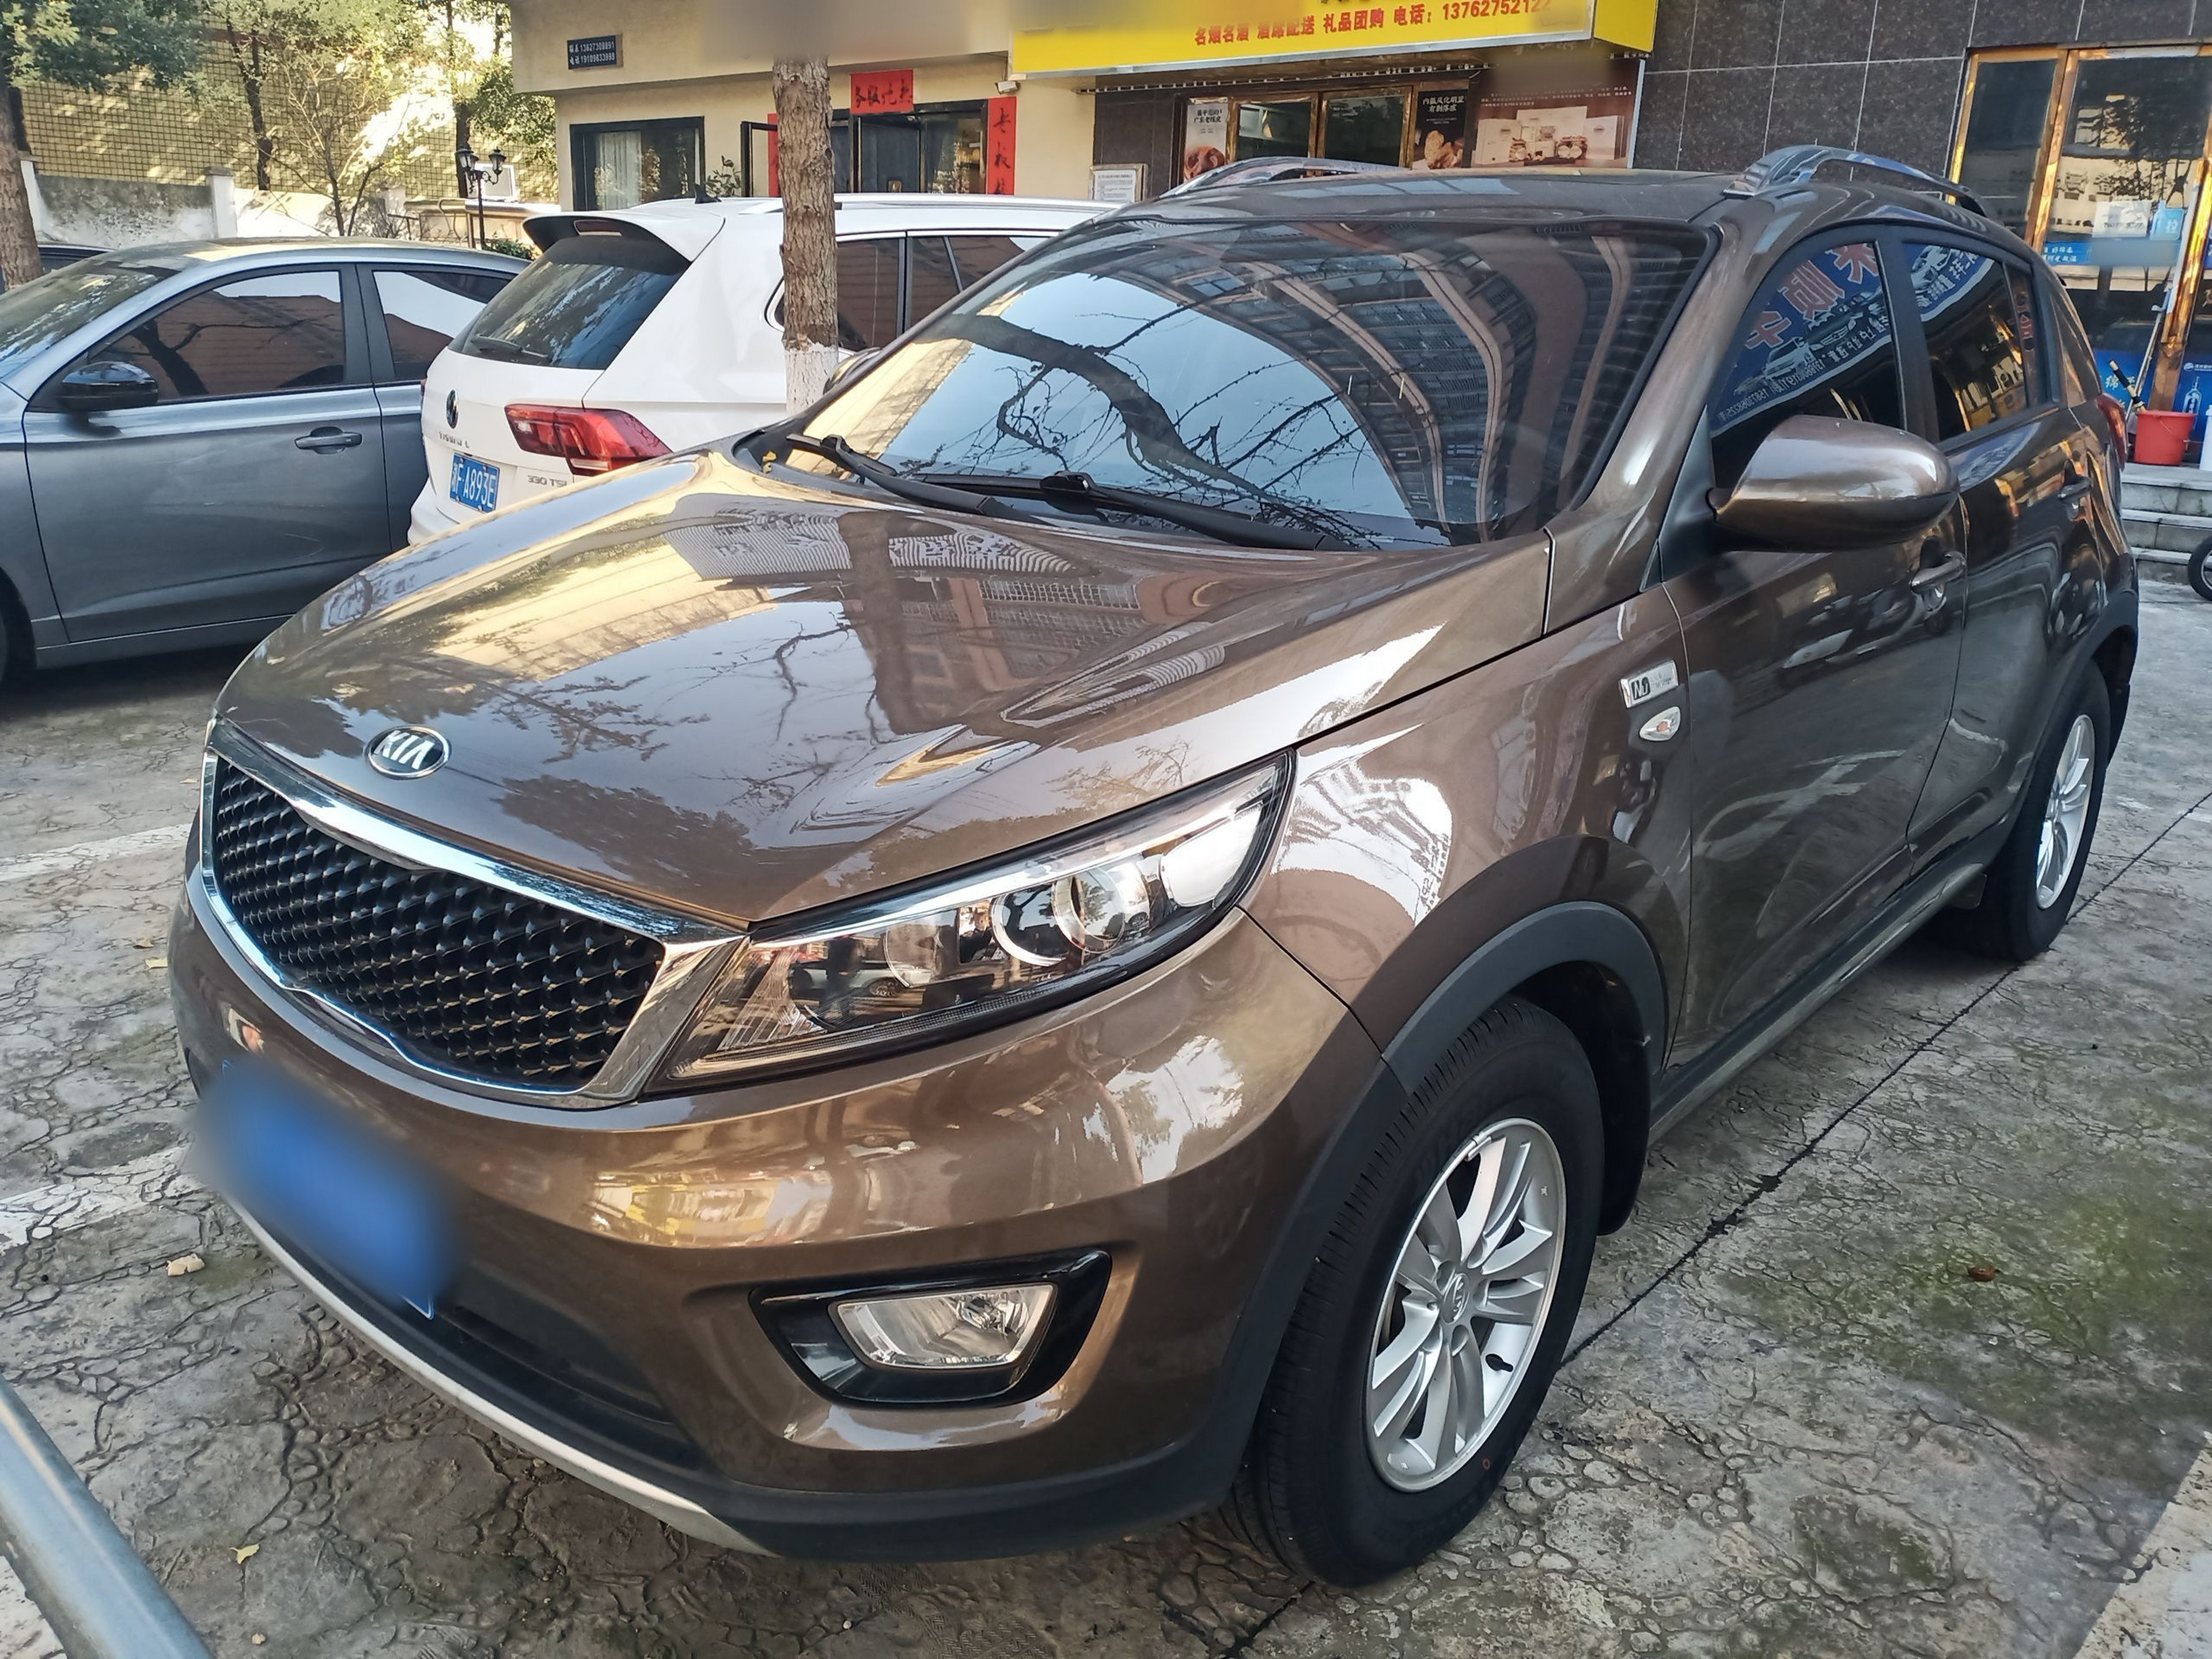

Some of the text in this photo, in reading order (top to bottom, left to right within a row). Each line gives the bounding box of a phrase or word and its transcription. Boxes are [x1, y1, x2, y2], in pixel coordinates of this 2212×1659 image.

[1323, 7, 1385, 33] 礼品团购
[527, 475, 567, 488] 330 TSI
[374, 729, 435, 770] KIA
